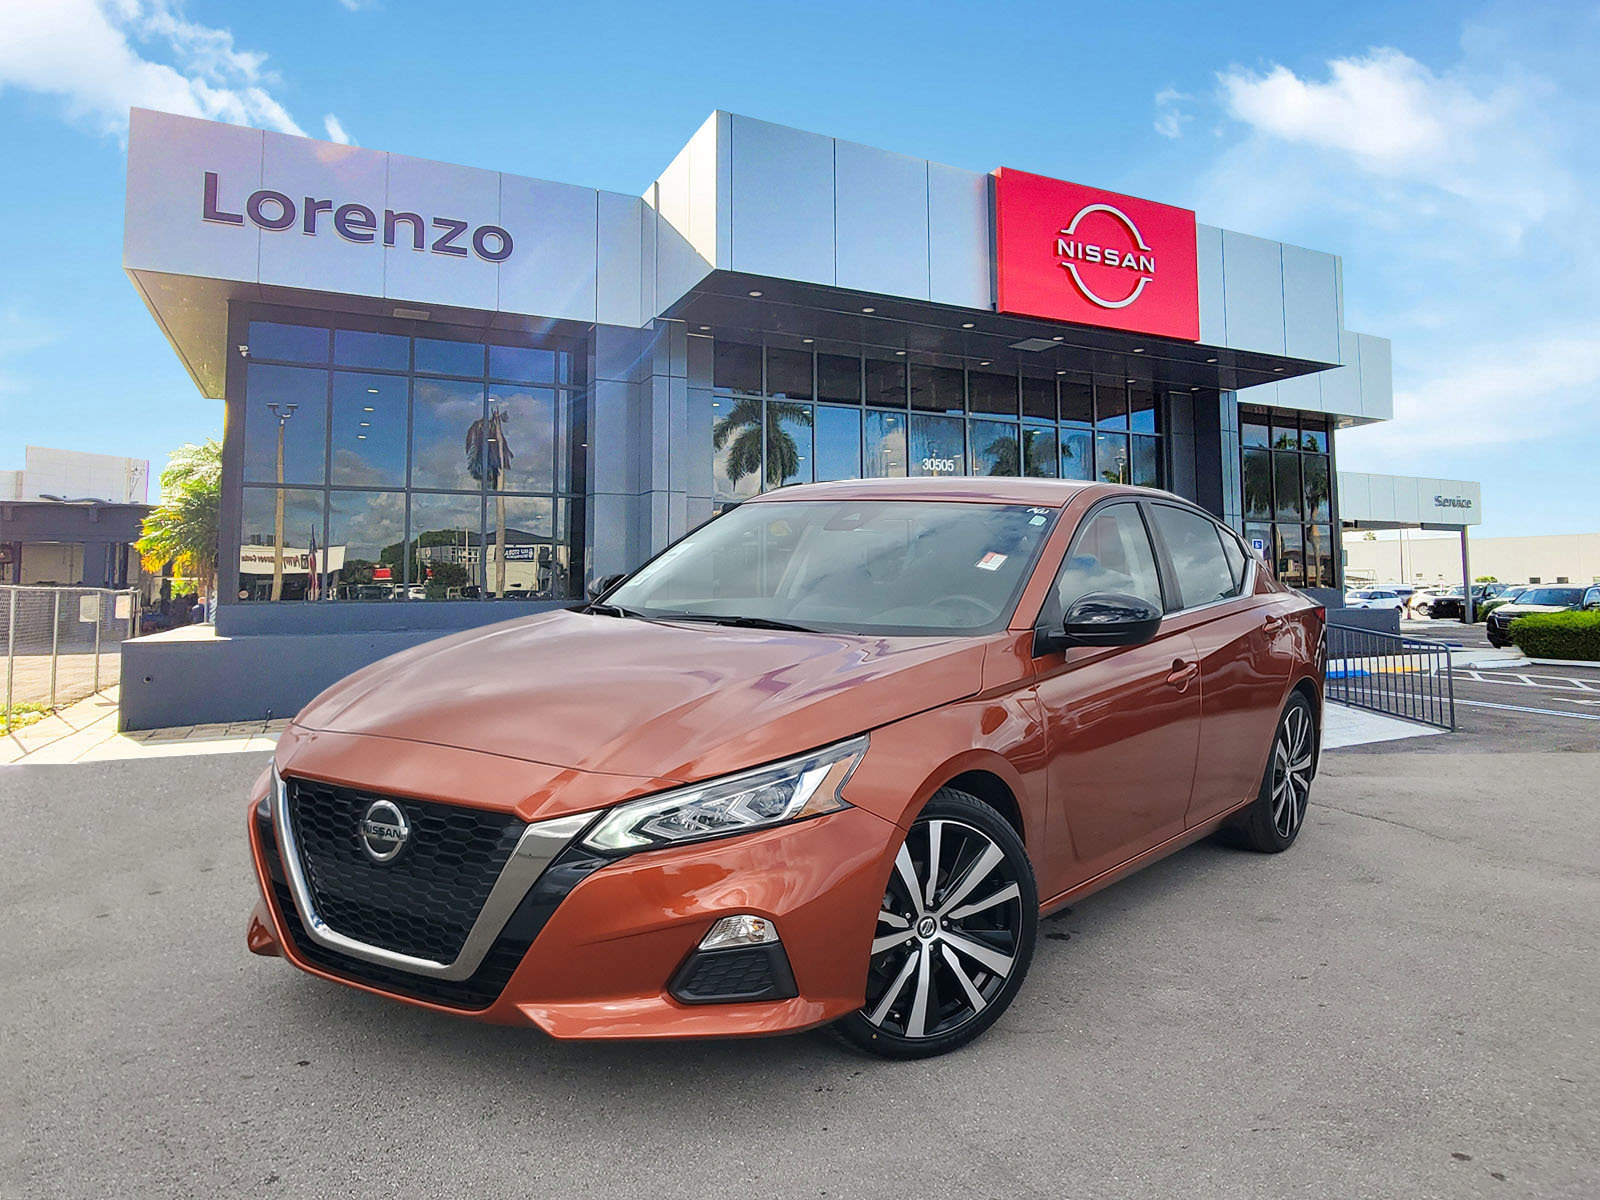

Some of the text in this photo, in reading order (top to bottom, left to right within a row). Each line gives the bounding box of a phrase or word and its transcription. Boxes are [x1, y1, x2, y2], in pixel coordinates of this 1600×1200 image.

[201, 171, 514, 263] Lorenzo
[1057, 238, 1156, 273] NISSAN
[922, 458, 954, 471] 30505
[1434, 495, 1472, 508] Service
[364, 824, 401, 838] NISSAN
